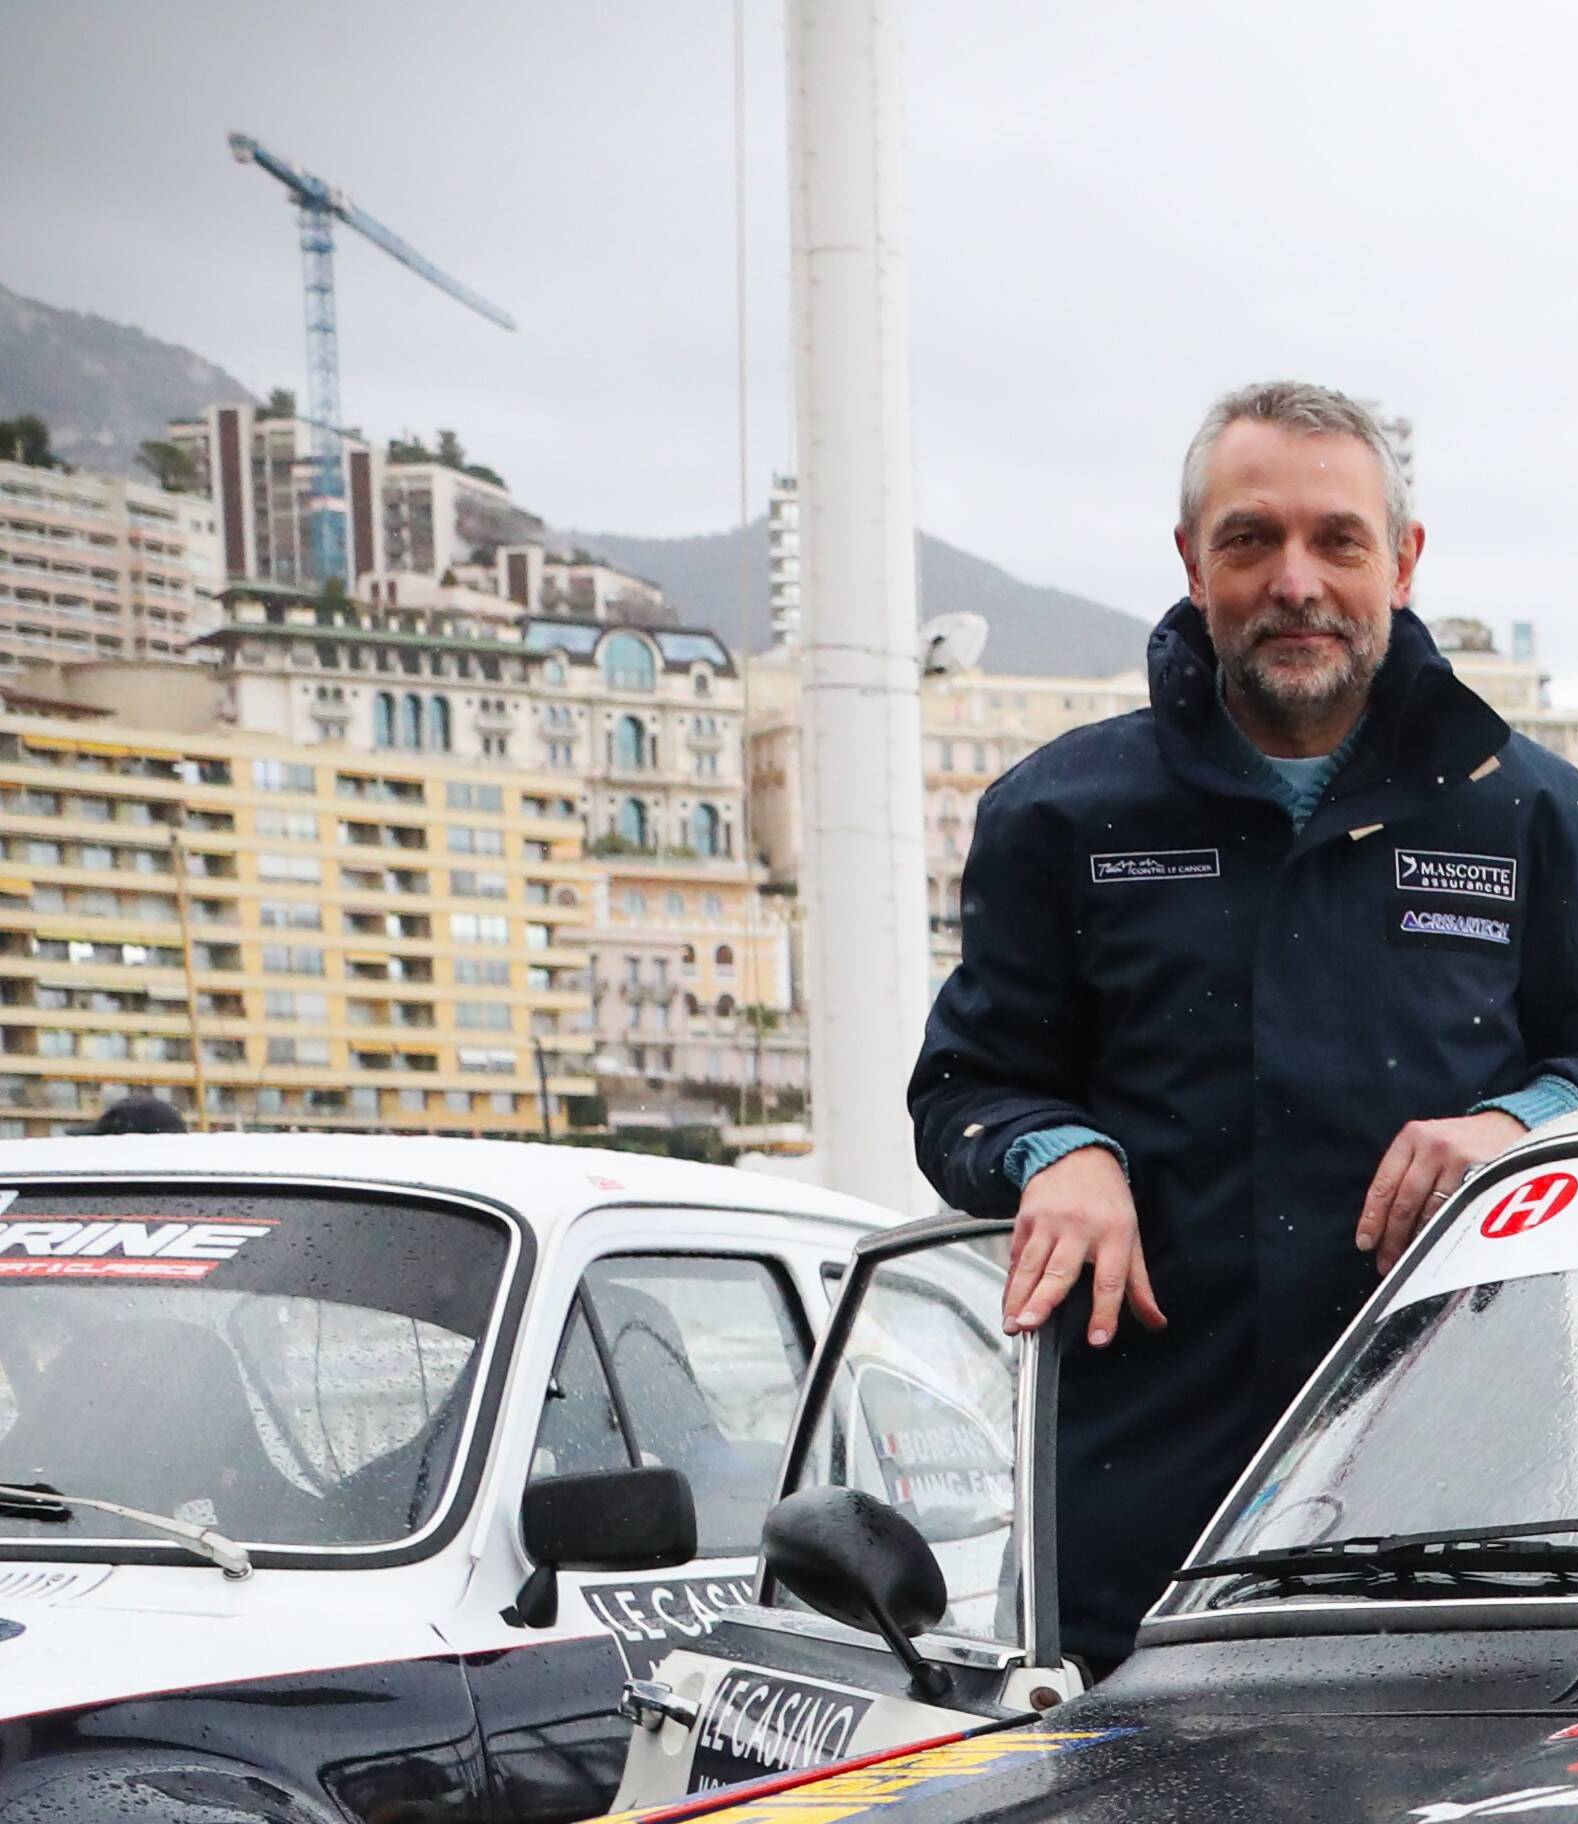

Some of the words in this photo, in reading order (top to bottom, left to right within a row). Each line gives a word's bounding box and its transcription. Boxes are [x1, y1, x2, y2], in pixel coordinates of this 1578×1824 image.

[1420, 862, 1510, 885] MASCOTTE
[1422, 877, 1510, 896] assurances
[0, 1222, 272, 1259] RINE
[591, 1590, 667, 1642] LE
[701, 1677, 745, 1751] LE
[731, 1684, 855, 1771] CASINO
